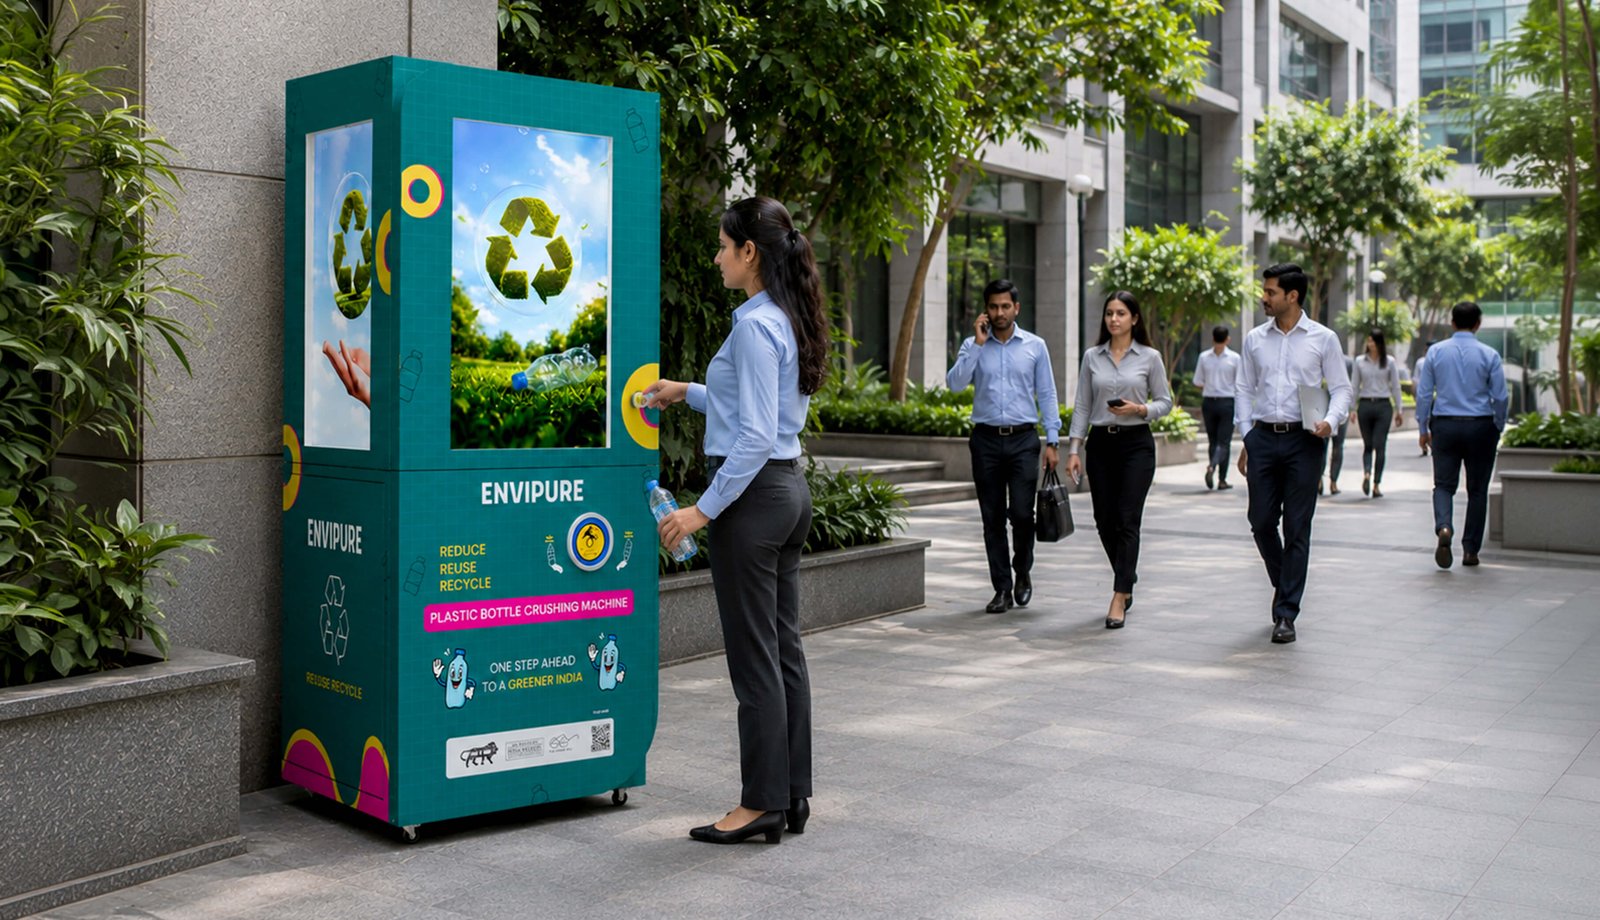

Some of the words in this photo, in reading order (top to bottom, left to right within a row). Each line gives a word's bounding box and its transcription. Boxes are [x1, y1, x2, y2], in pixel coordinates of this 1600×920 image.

[481, 479, 584, 505] ENVIPURE
[307, 518, 362, 554] ENVIPURE
[440, 543, 486, 558] REDUCE
[440, 561, 477, 575] REUSE
[440, 577, 492, 592] RECYCLE
[430, 608, 478, 624] PLASTIC
[480, 605, 521, 620] BOTTLE
[524, 601, 579, 616] CRUSHING
[581, 597, 628, 611] MACHINE
[489, 661, 512, 674] ONE
[514, 658, 539, 672] STEP
[541, 655, 576, 669] AHEAD
[331, 679, 362, 700] RECYCLE
[482, 680, 497, 693] TO
[498, 681, 506, 691] A
[507, 675, 554, 690] GREENER
[556, 672, 583, 685] INDIA
